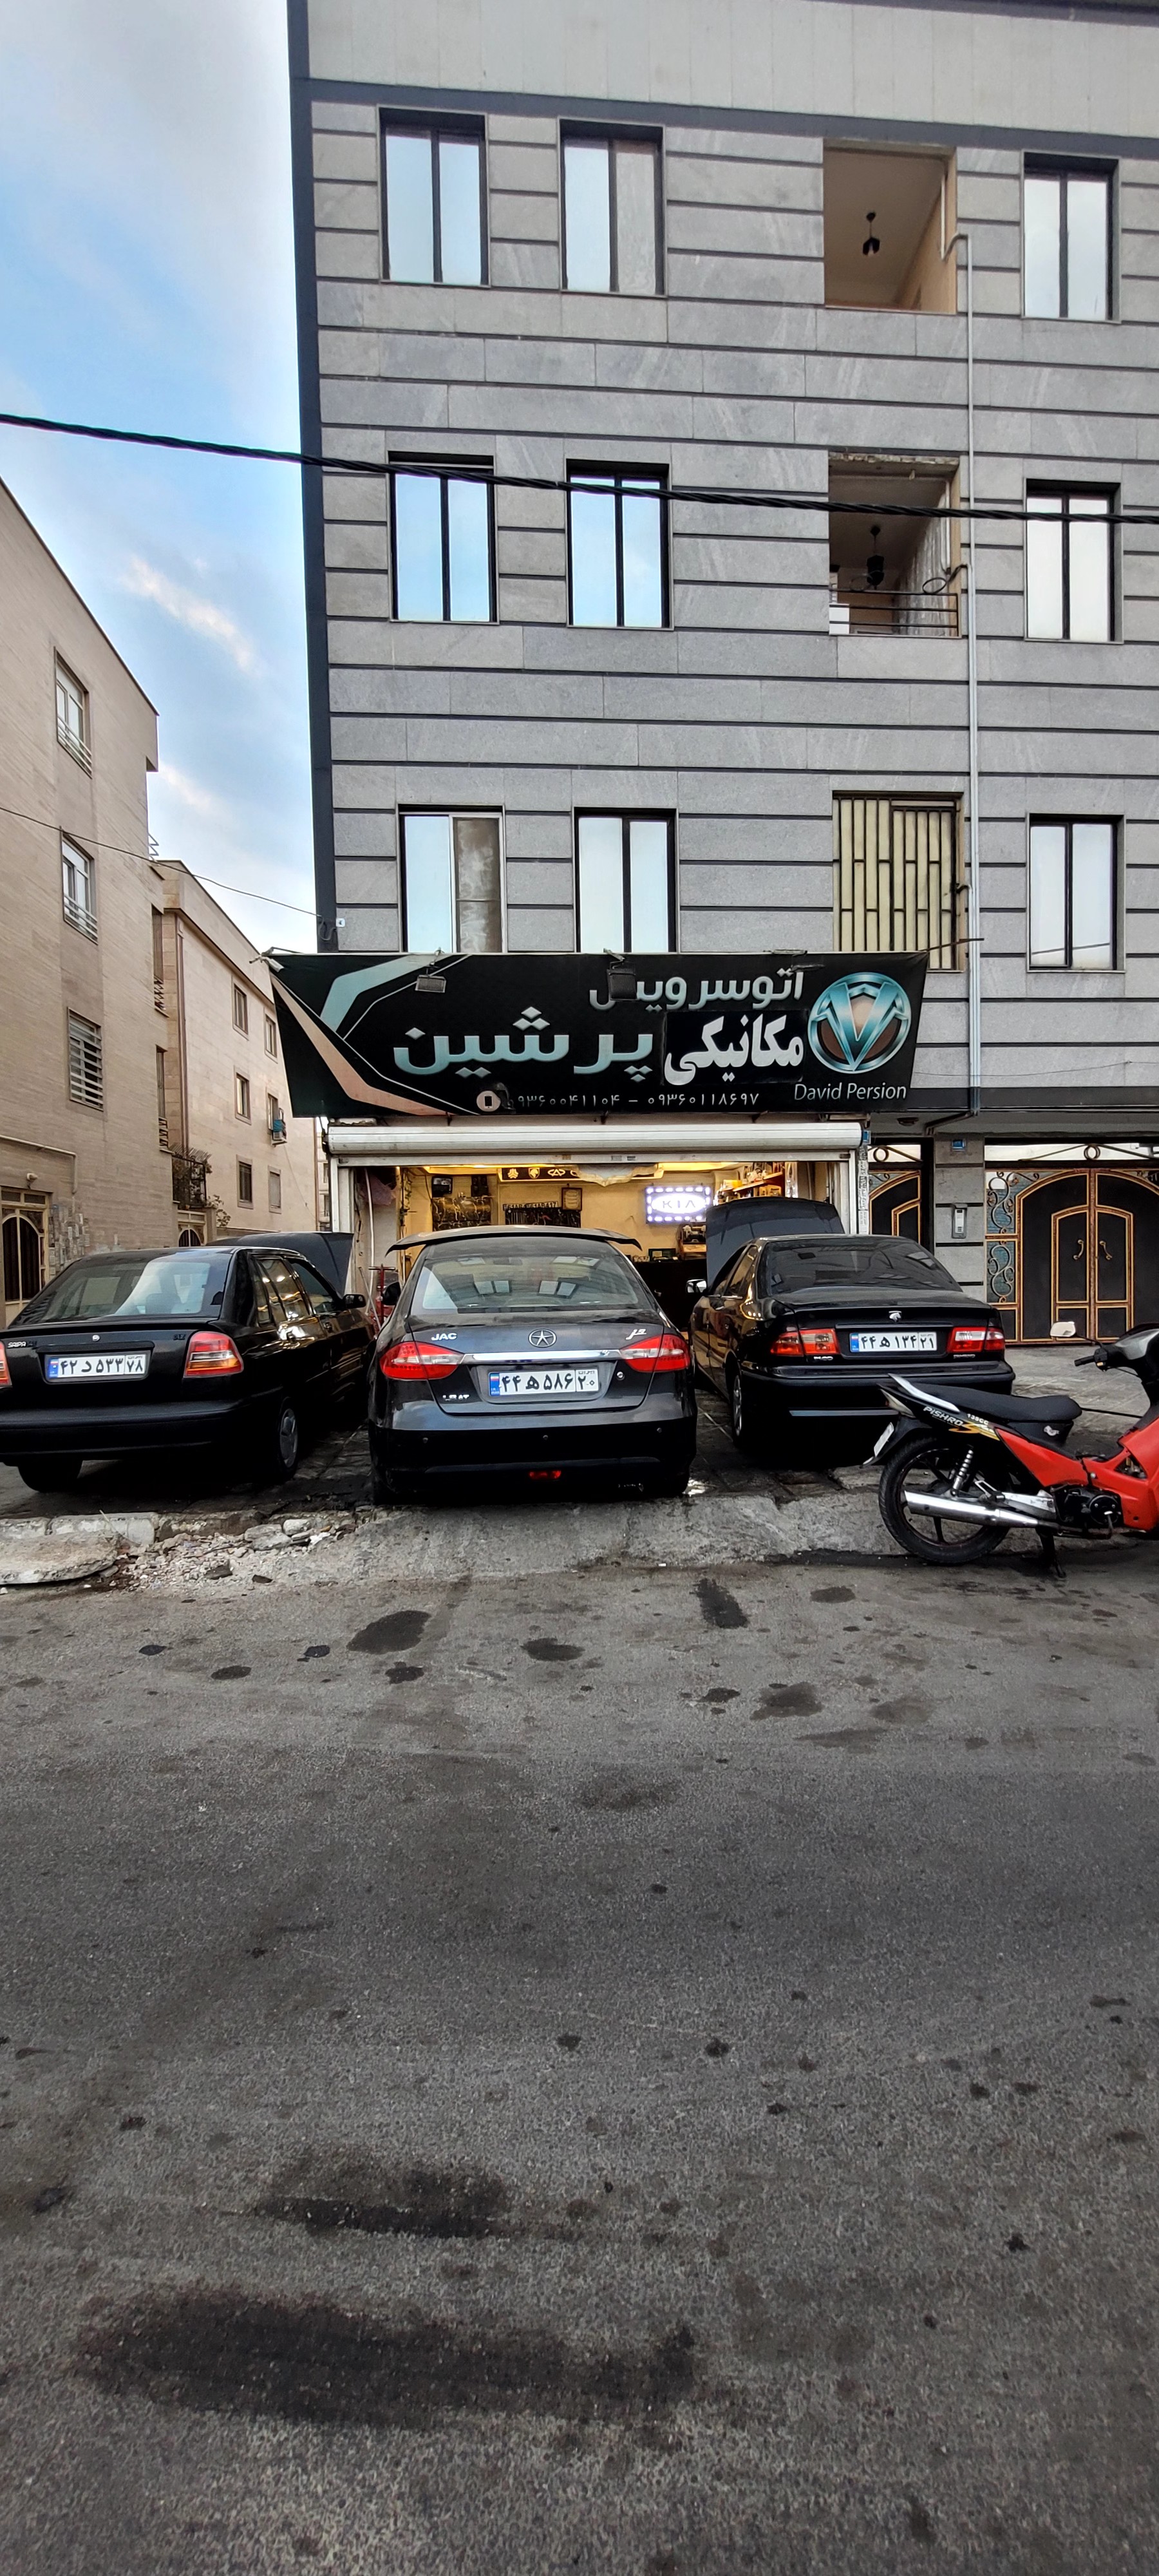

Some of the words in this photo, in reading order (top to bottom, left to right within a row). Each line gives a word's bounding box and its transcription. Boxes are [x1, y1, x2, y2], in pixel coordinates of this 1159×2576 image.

[664, 1013, 804, 1086] مکانیکی
[794, 1082, 842, 1101] David
[847, 1082, 907, 1100] Persion
[507, 1095, 620, 1107] ۹۳۶۰۰۴۱۱۰۴
[662, 1200, 696, 1208] KIA
[431, 1332, 457, 1341] JAC
